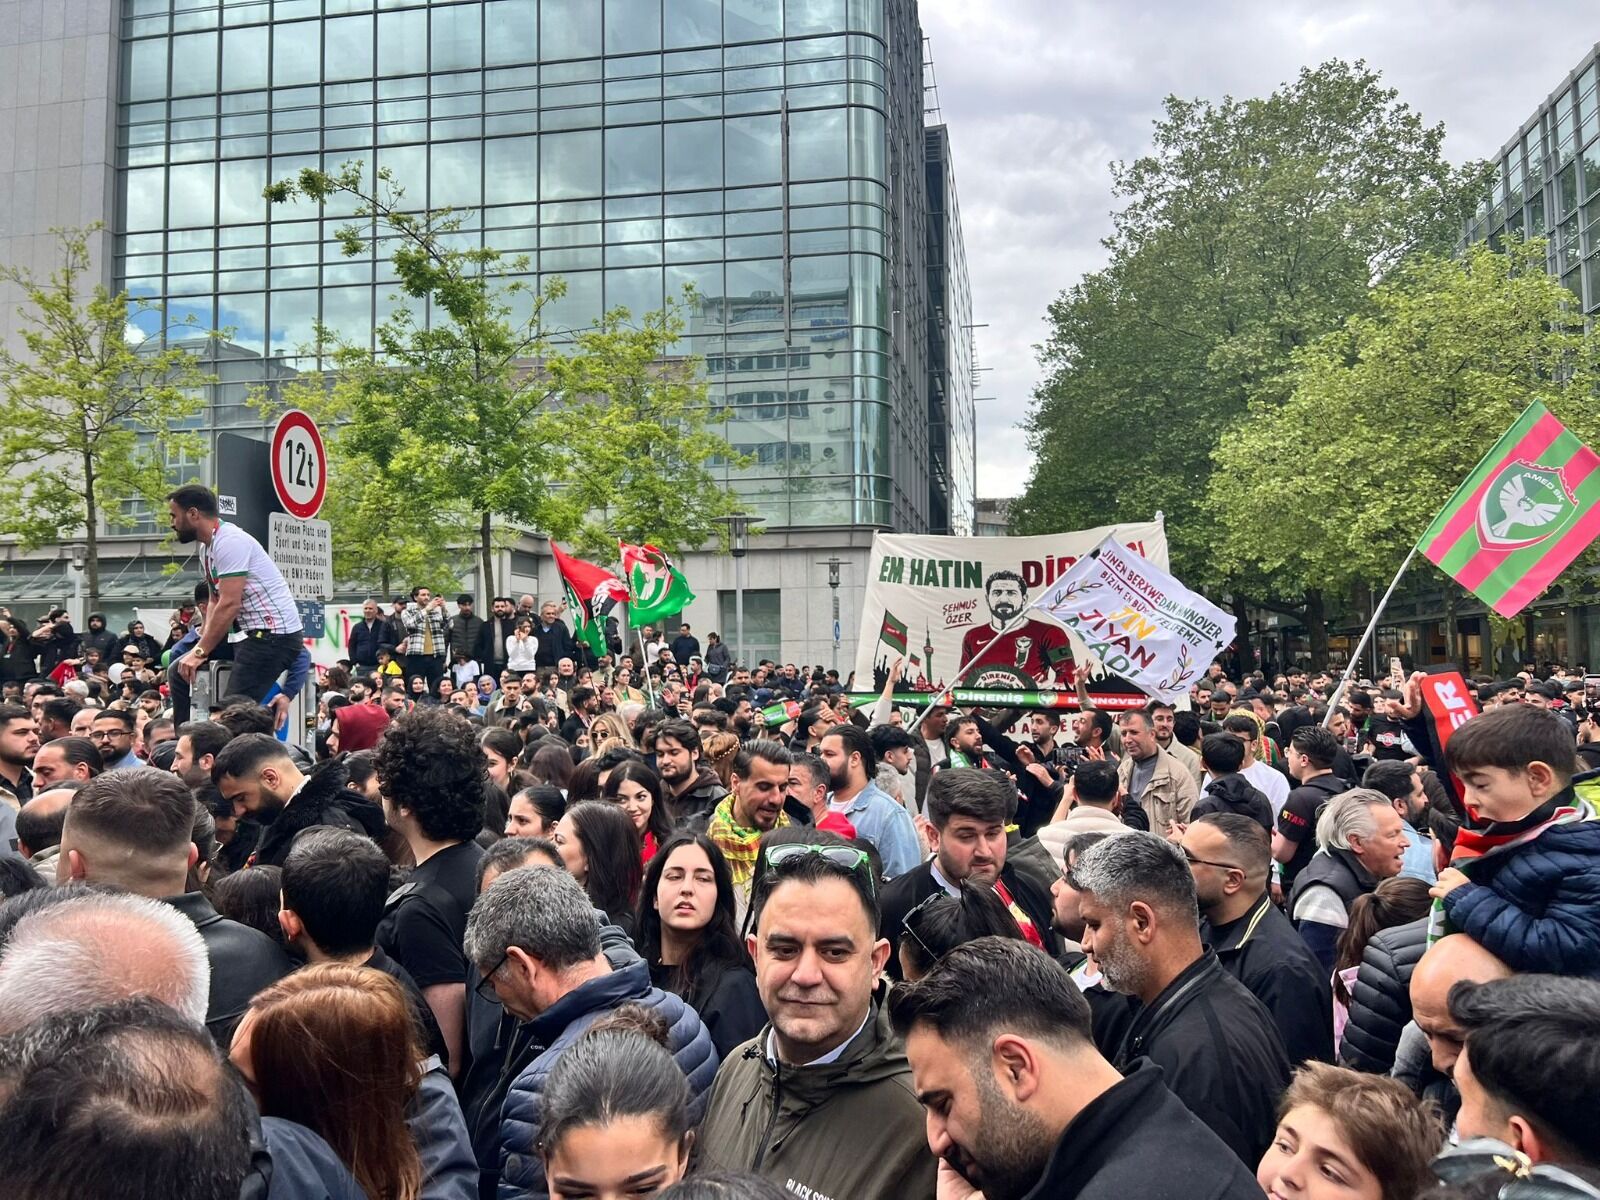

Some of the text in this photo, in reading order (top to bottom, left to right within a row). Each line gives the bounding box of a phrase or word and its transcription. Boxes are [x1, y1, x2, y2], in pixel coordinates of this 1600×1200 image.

[286, 439, 314, 489] 12t
[1523, 472, 1555, 490] AMED
[274, 521, 327, 539] Auf diesem Platz sind
[275, 535, 290, 550] Sport
[292, 540, 301, 550] und
[303, 538, 316, 552] Spiel
[879, 556, 905, 584] EM
[909, 558, 983, 589] HATIN
[299, 582, 323, 595] erlaubt
[945, 612, 973, 625] ÖZER
[957, 688, 1024, 705] DİRENİŞ
